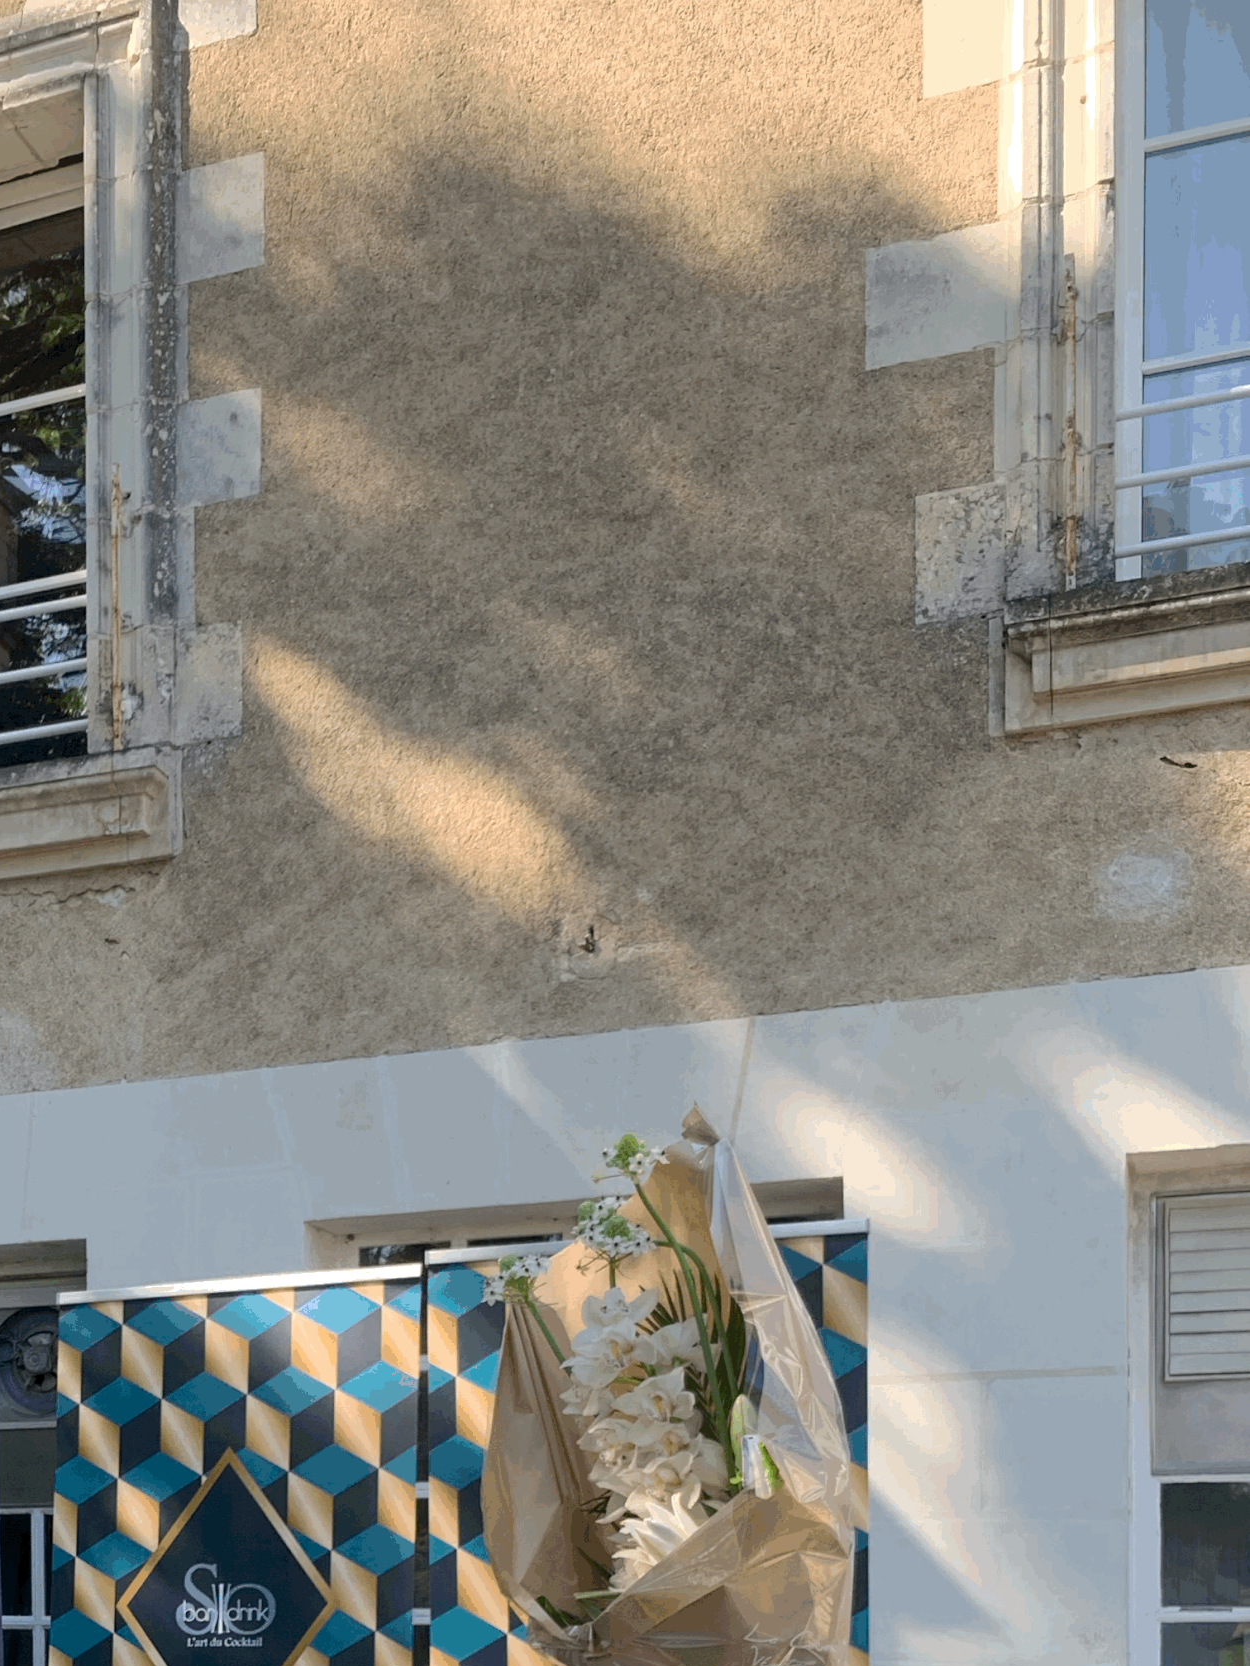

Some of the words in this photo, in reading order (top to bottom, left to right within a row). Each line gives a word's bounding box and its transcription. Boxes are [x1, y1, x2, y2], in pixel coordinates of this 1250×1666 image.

[183, 1599, 217, 1622] bar
[186, 1637, 208, 1648] L'art
[209, 1637, 223, 1648] du
[224, 1637, 263, 1648] Cocktail
